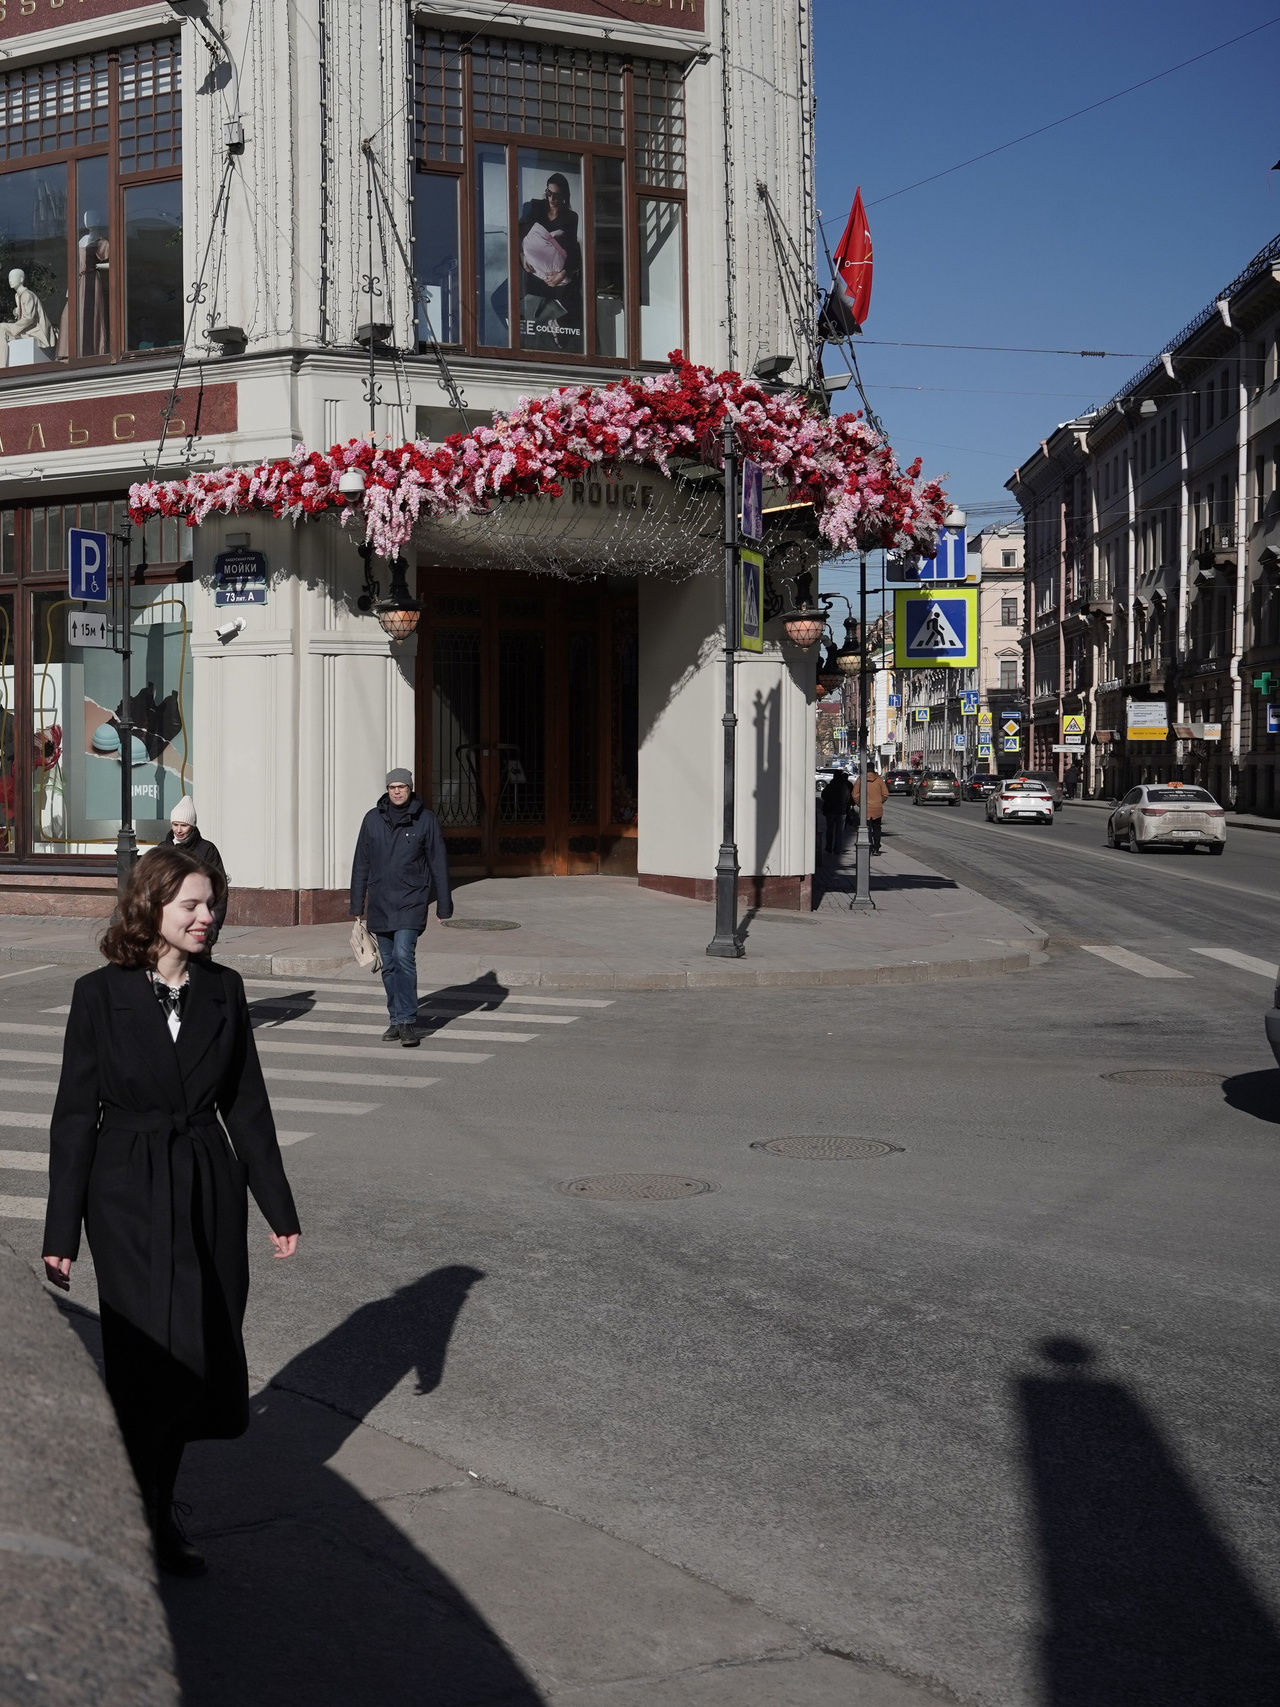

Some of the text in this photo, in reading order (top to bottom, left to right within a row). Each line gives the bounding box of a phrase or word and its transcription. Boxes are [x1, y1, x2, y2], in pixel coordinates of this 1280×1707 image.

[536, 325, 581, 336] COLLECTIVE
[572, 481, 654, 507] ROUGE
[81, 538, 100, 591] P
[224, 562, 257, 574] МОЙКИ
[225, 592, 235, 602] 73
[248, 592, 255, 601] А
[81, 623, 96, 637] 15м
[131, 784, 160, 800] MPER
